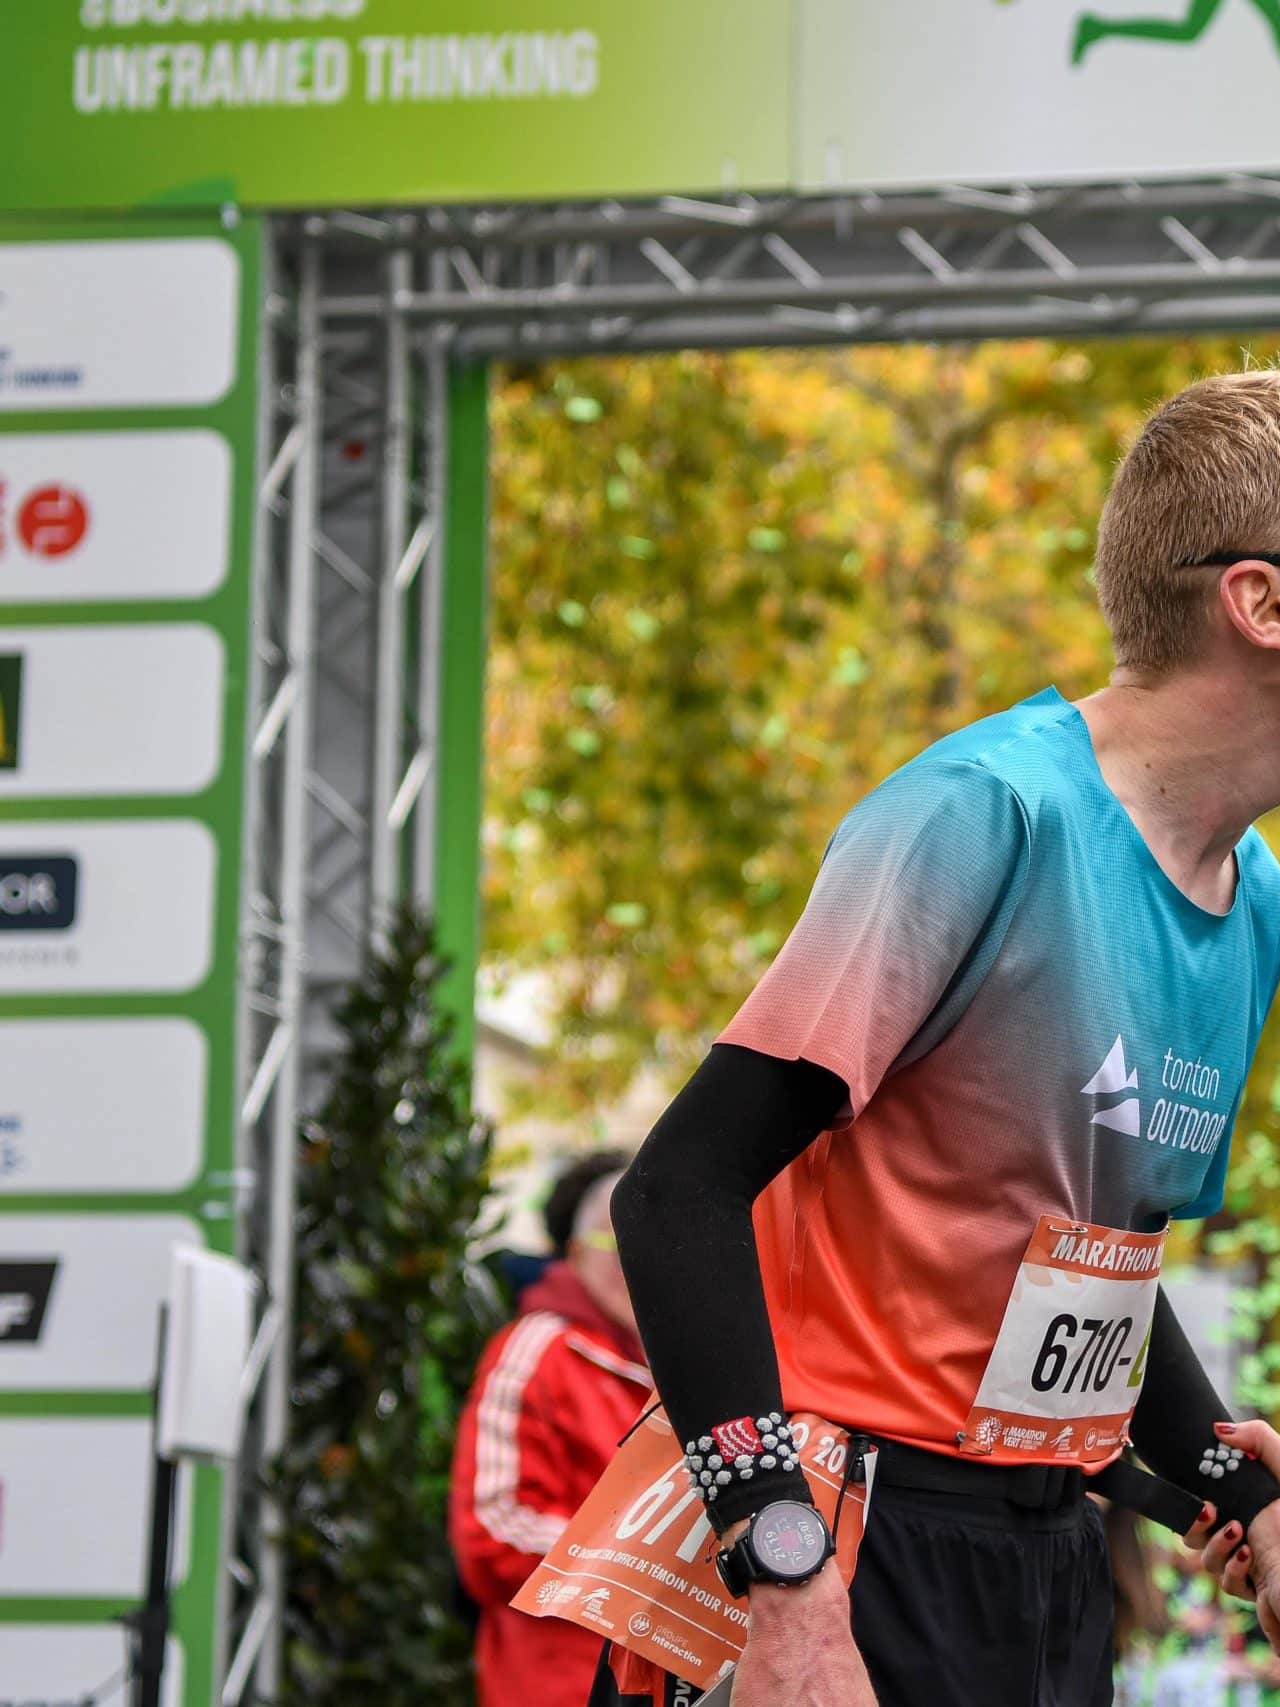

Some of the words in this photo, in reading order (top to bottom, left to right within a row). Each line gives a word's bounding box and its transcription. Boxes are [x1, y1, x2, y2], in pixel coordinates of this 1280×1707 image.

[73, 37, 350, 113] UNFRAMED
[359, 31, 598, 101] THINKING
[1162, 1047, 1220, 1100] tonton
[1147, 1098, 1228, 1155] OUTDOOR
[1051, 1234, 1155, 1272] MARATHON
[812, 1436, 846, 1479] 20
[648, 1563, 688, 1593] TÉMOIN
[688, 1585, 721, 1612] POUR
